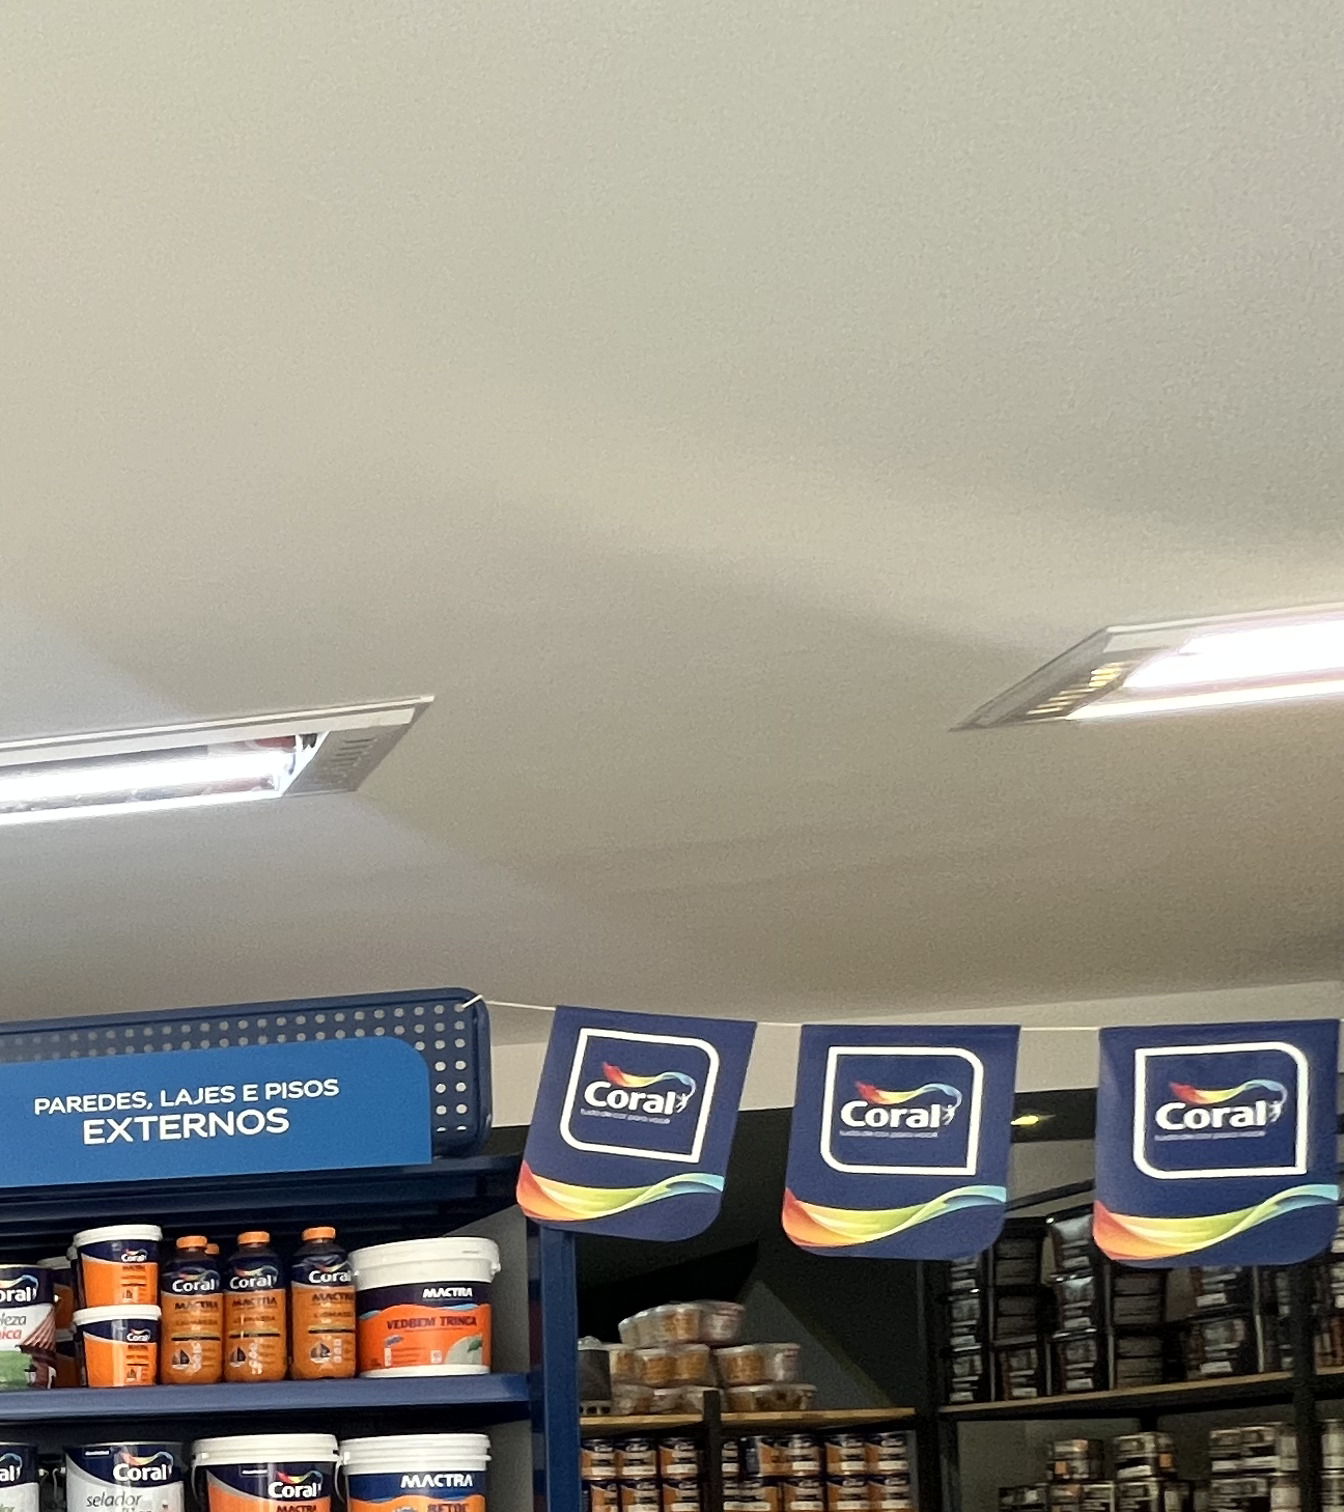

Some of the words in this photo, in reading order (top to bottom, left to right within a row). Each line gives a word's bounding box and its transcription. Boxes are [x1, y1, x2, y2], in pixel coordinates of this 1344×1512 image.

[34, 1090, 152, 1116] PAREDES,
[160, 1084, 235, 1110] LAJES
[243, 1082, 257, 1101] E
[264, 1078, 339, 1099] PISOS
[584, 1080, 676, 1115] Coral
[840, 1100, 940, 1128] Coral
[1155, 1100, 1266, 1130] Coral
[83, 1108, 290, 1146] EXTERNOS
[172, 1279, 215, 1292] Coral
[229, 1275, 272, 1288] Coral
[423, 1287, 472, 1298] MACTRA
[113, 1462, 166, 1481] Coral
[268, 1481, 316, 1498] Coral
[400, 1474, 473, 1489] MACTRA
[87, 1493, 141, 1508] selador
